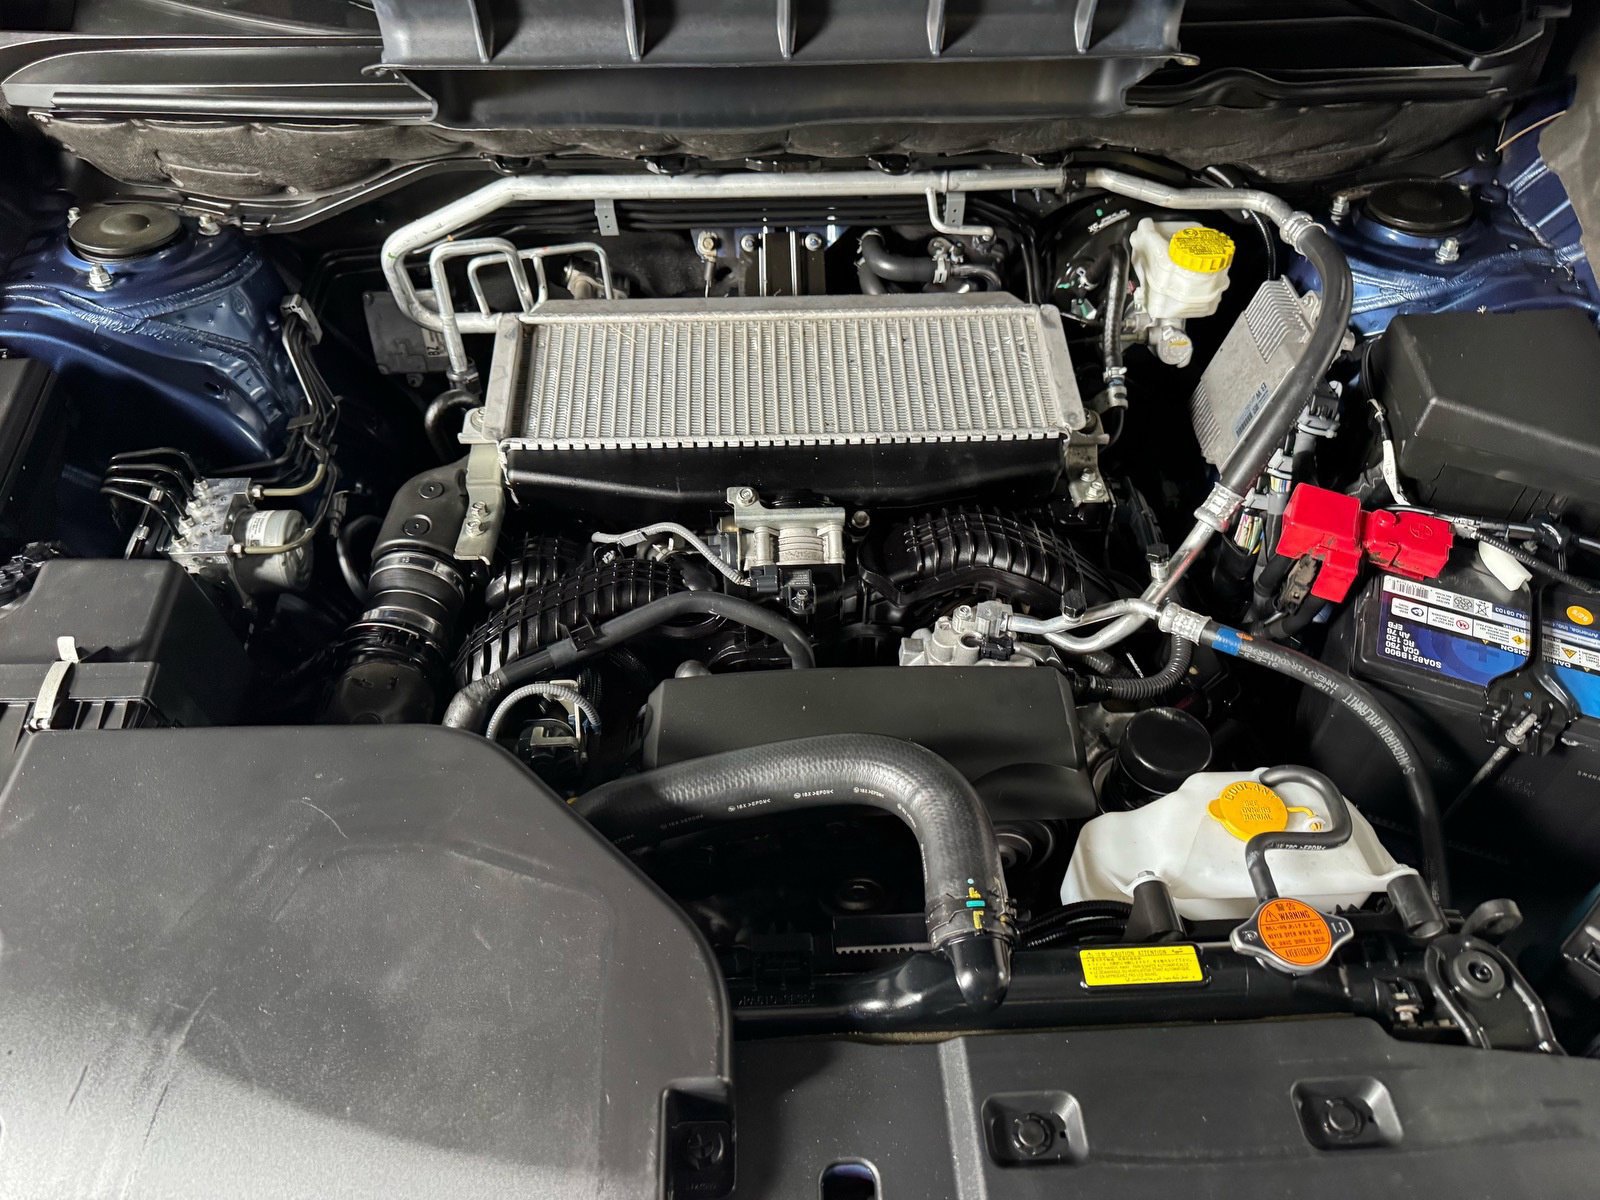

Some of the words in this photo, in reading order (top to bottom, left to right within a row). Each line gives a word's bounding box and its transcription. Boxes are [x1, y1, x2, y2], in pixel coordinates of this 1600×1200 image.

[1388, 621, 1403, 631] EFB
[1386, 634, 1401, 643] 120
[1399, 631, 1410, 639] Ah
[1403, 639, 1415, 648] RC
[1402, 645, 1420, 656] CCA
[1224, 782, 1281, 801] COOLANT
[1278, 910, 1311, 921] WARNING
